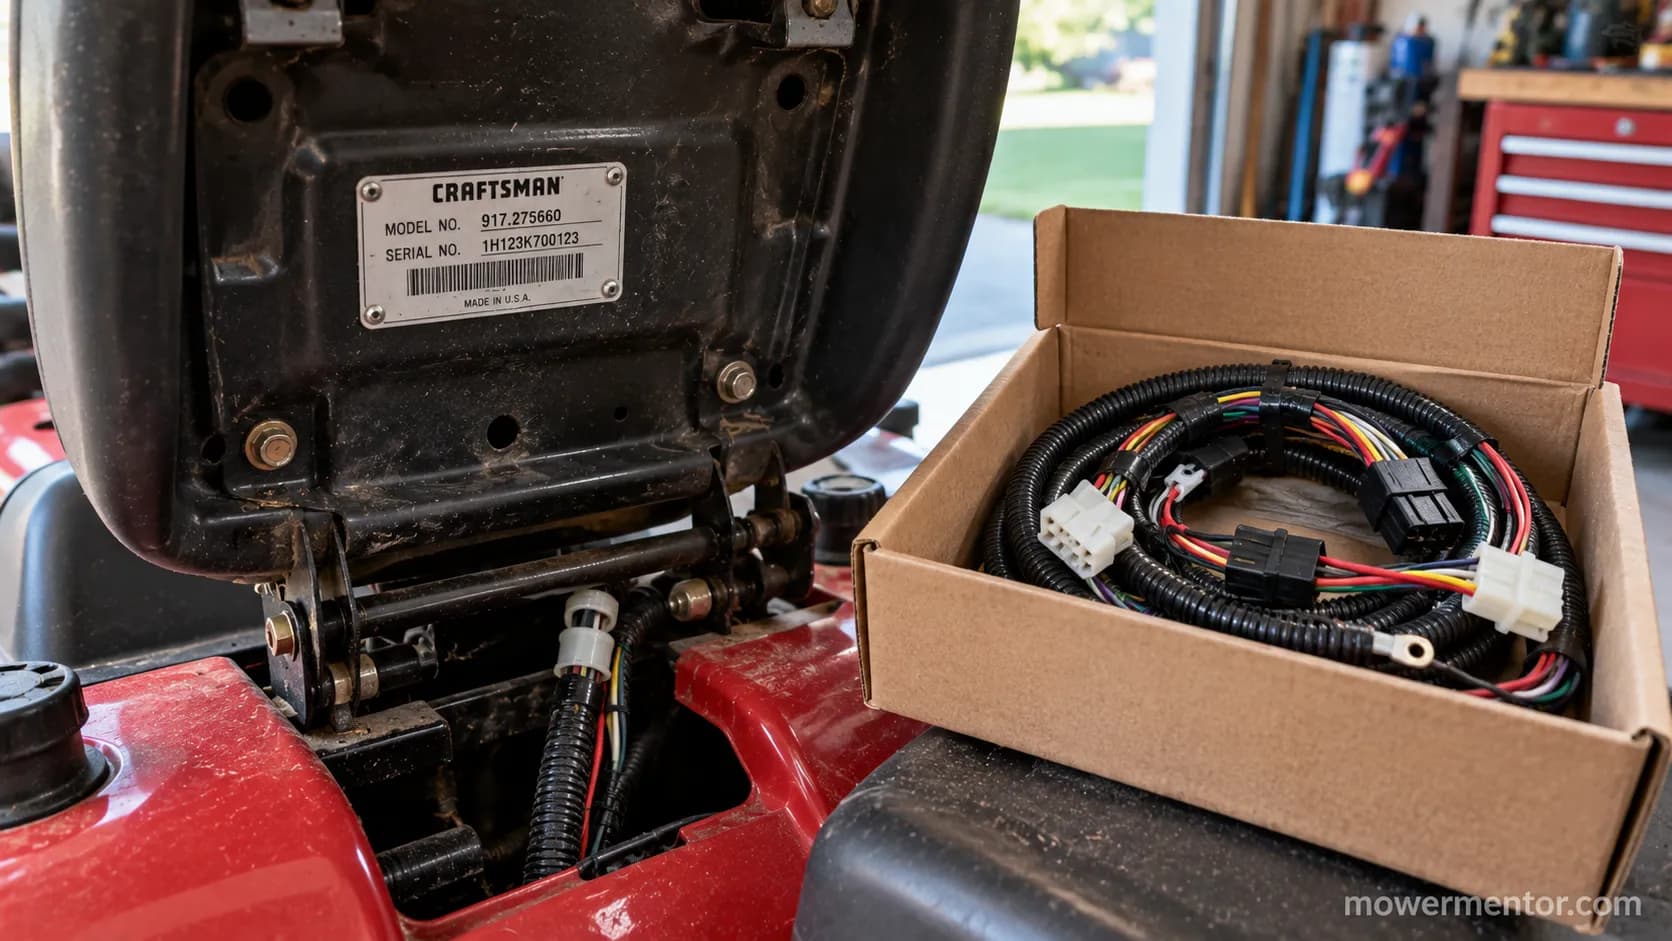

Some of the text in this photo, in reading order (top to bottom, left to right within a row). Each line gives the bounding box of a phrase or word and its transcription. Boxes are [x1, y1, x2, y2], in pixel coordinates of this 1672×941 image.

[432, 176, 561, 203] CRAFTSMAN
[385, 209, 562, 236] MODEL NO. 917.275660
[386, 231, 579, 262] SERIAL NO. 1H123K700123
[464, 293, 531, 308] MADE IN U.S.A.
